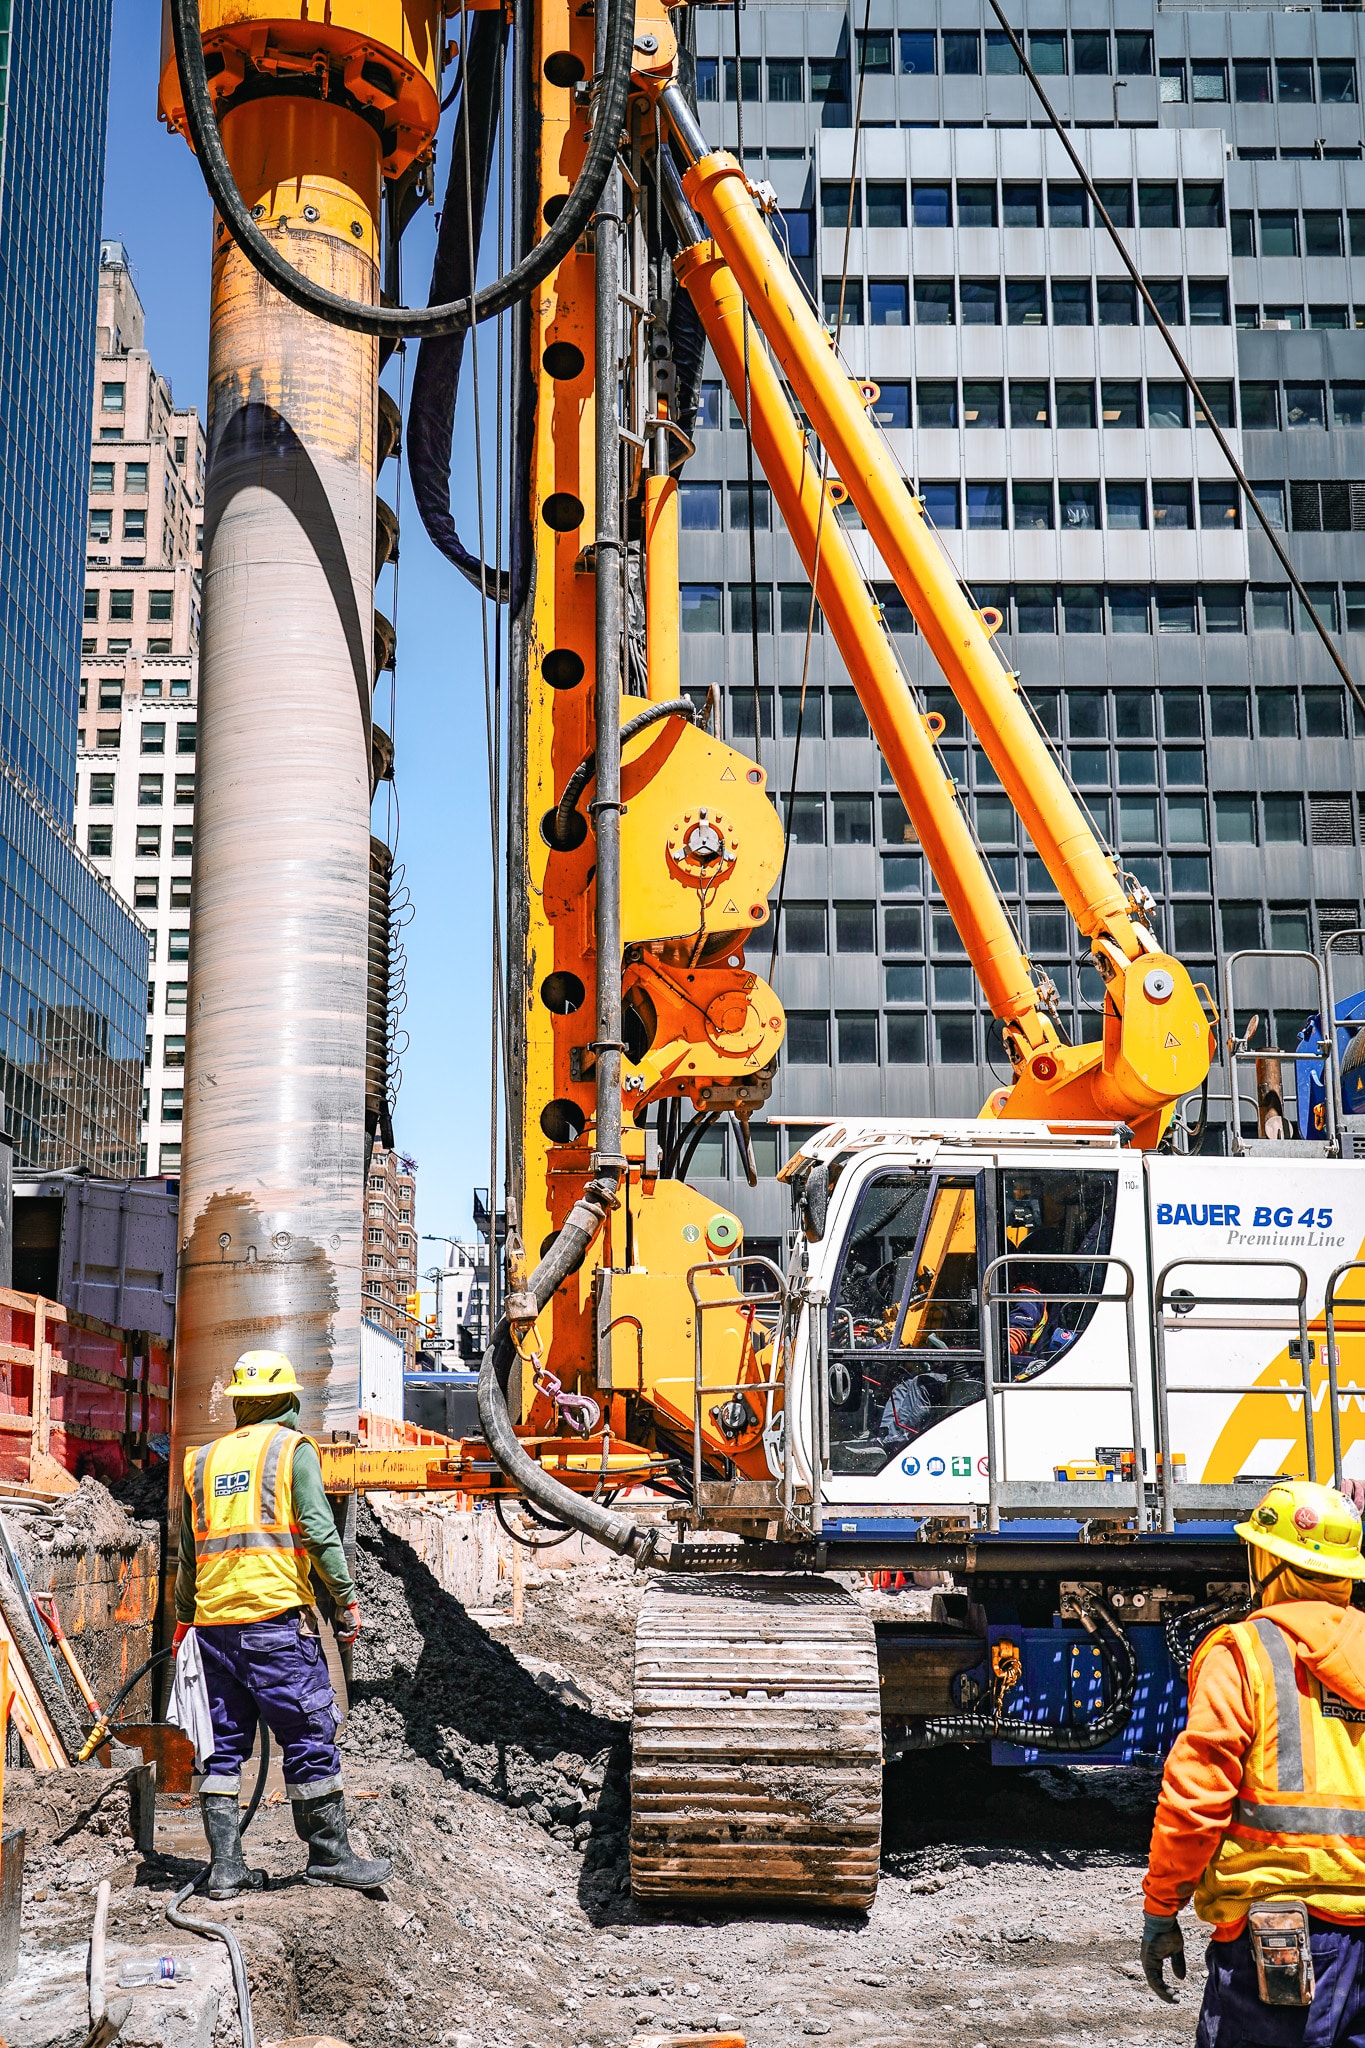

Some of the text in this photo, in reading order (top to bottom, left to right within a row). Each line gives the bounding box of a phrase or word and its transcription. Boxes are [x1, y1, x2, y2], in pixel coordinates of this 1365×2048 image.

[1157, 1203, 1333, 1228] BAUER BG 45
[1226, 1230, 1345, 1247] PremiumLine
[215, 1471, 249, 1490] ECD
